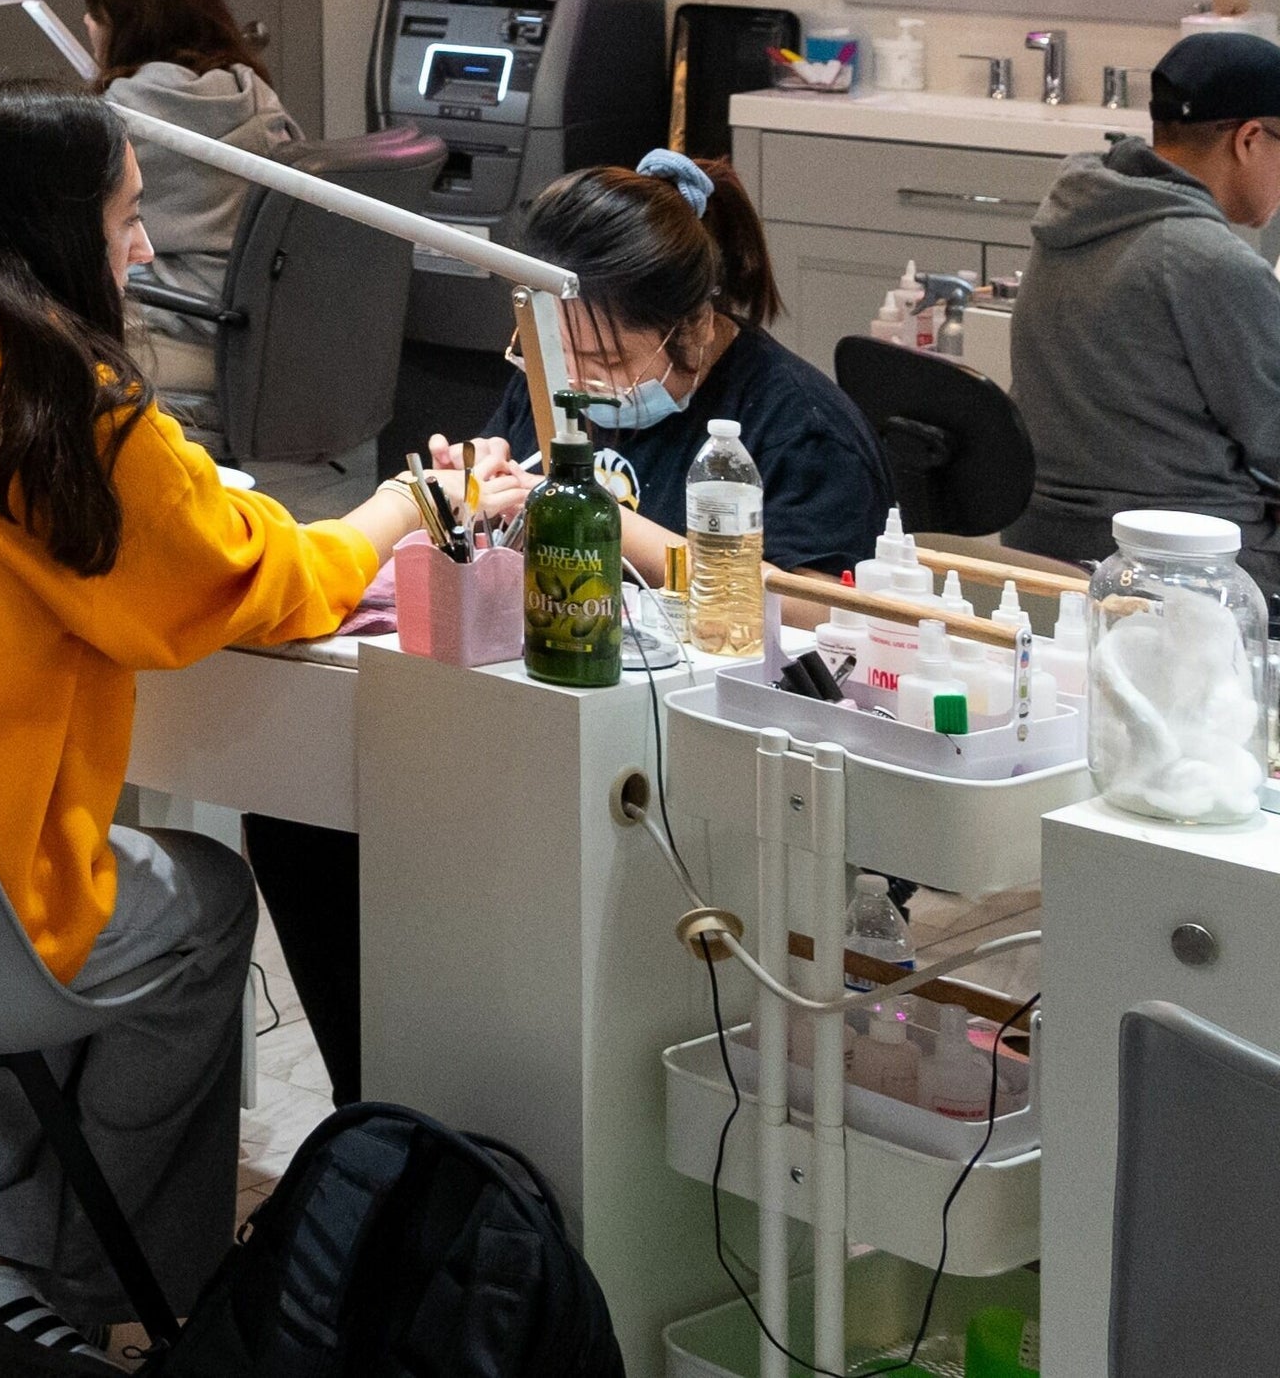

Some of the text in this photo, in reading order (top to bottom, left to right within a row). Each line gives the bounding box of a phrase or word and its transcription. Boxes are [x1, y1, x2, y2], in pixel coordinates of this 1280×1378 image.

[537, 544, 599, 562] DREAM
[528, 591, 612, 617] Olive Oil
